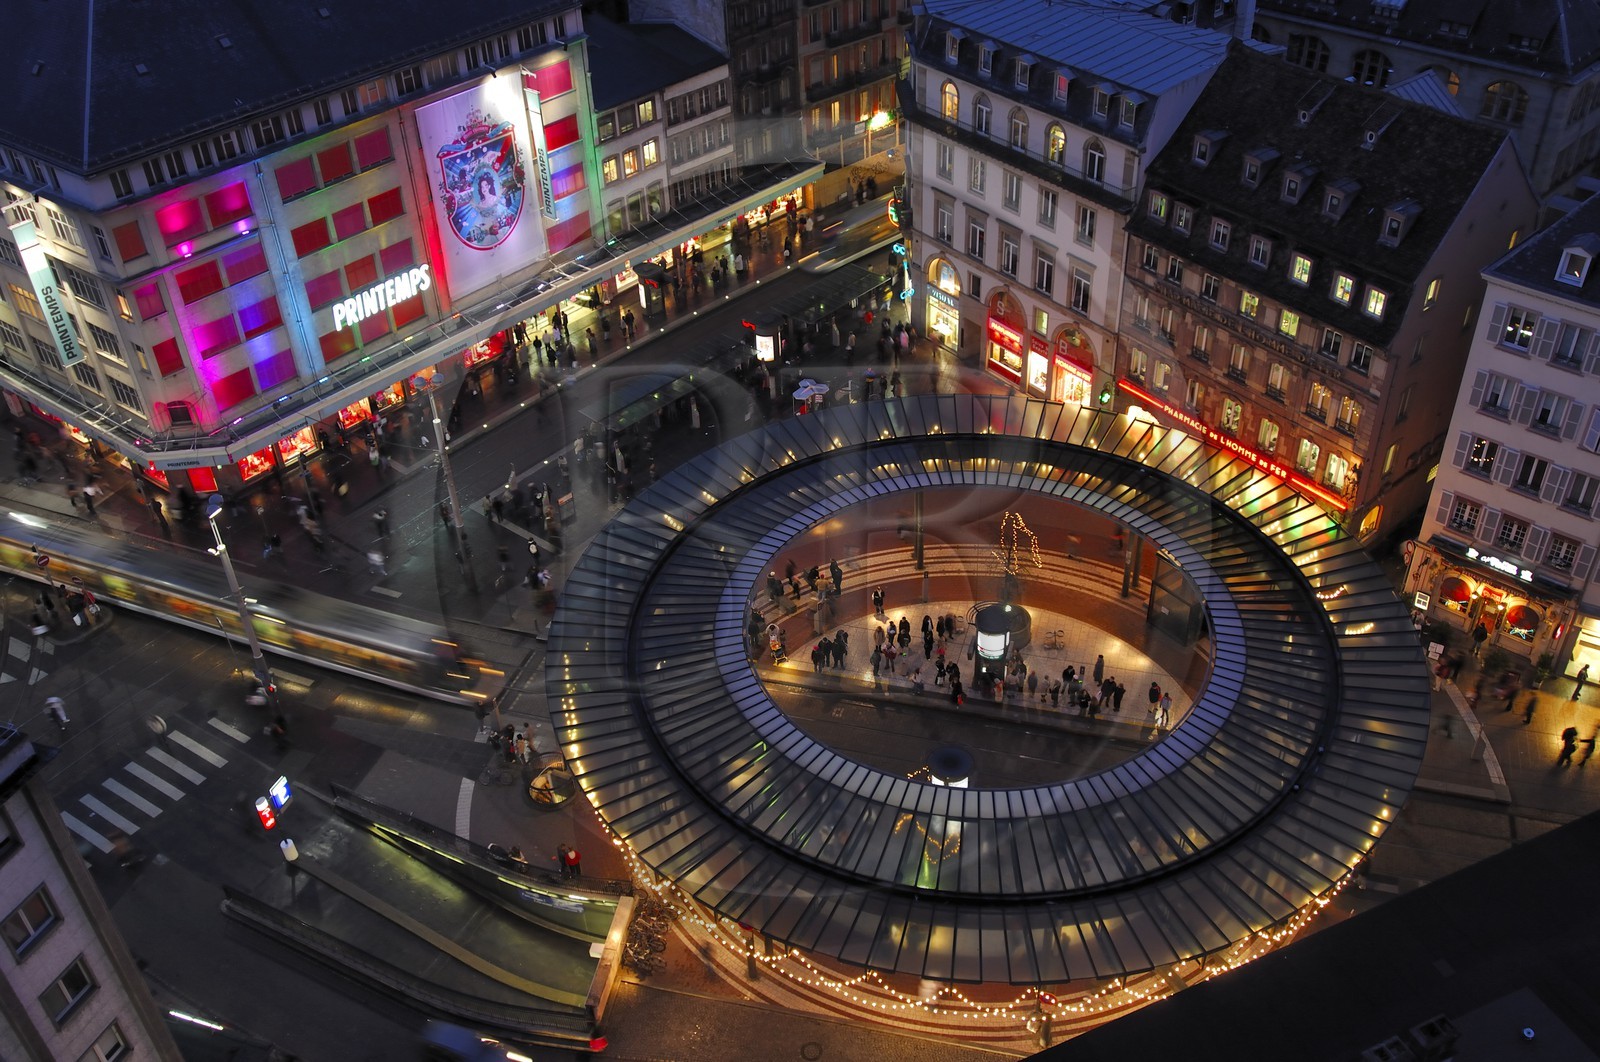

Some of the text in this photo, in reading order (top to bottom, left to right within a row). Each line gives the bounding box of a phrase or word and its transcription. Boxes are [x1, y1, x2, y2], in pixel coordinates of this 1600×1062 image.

[538, 147, 553, 215] PRINTEMPS
[41, 285, 78, 361] PRINTEMPS
[332, 263, 431, 332] PRINTEMPS
[166, 460, 201, 469] PRINTEMPS
[1163, 404, 1207, 434] PHARMACIE
[1220, 435, 1258, 461] L'HOMME
[1270, 463, 1287, 478] FER
